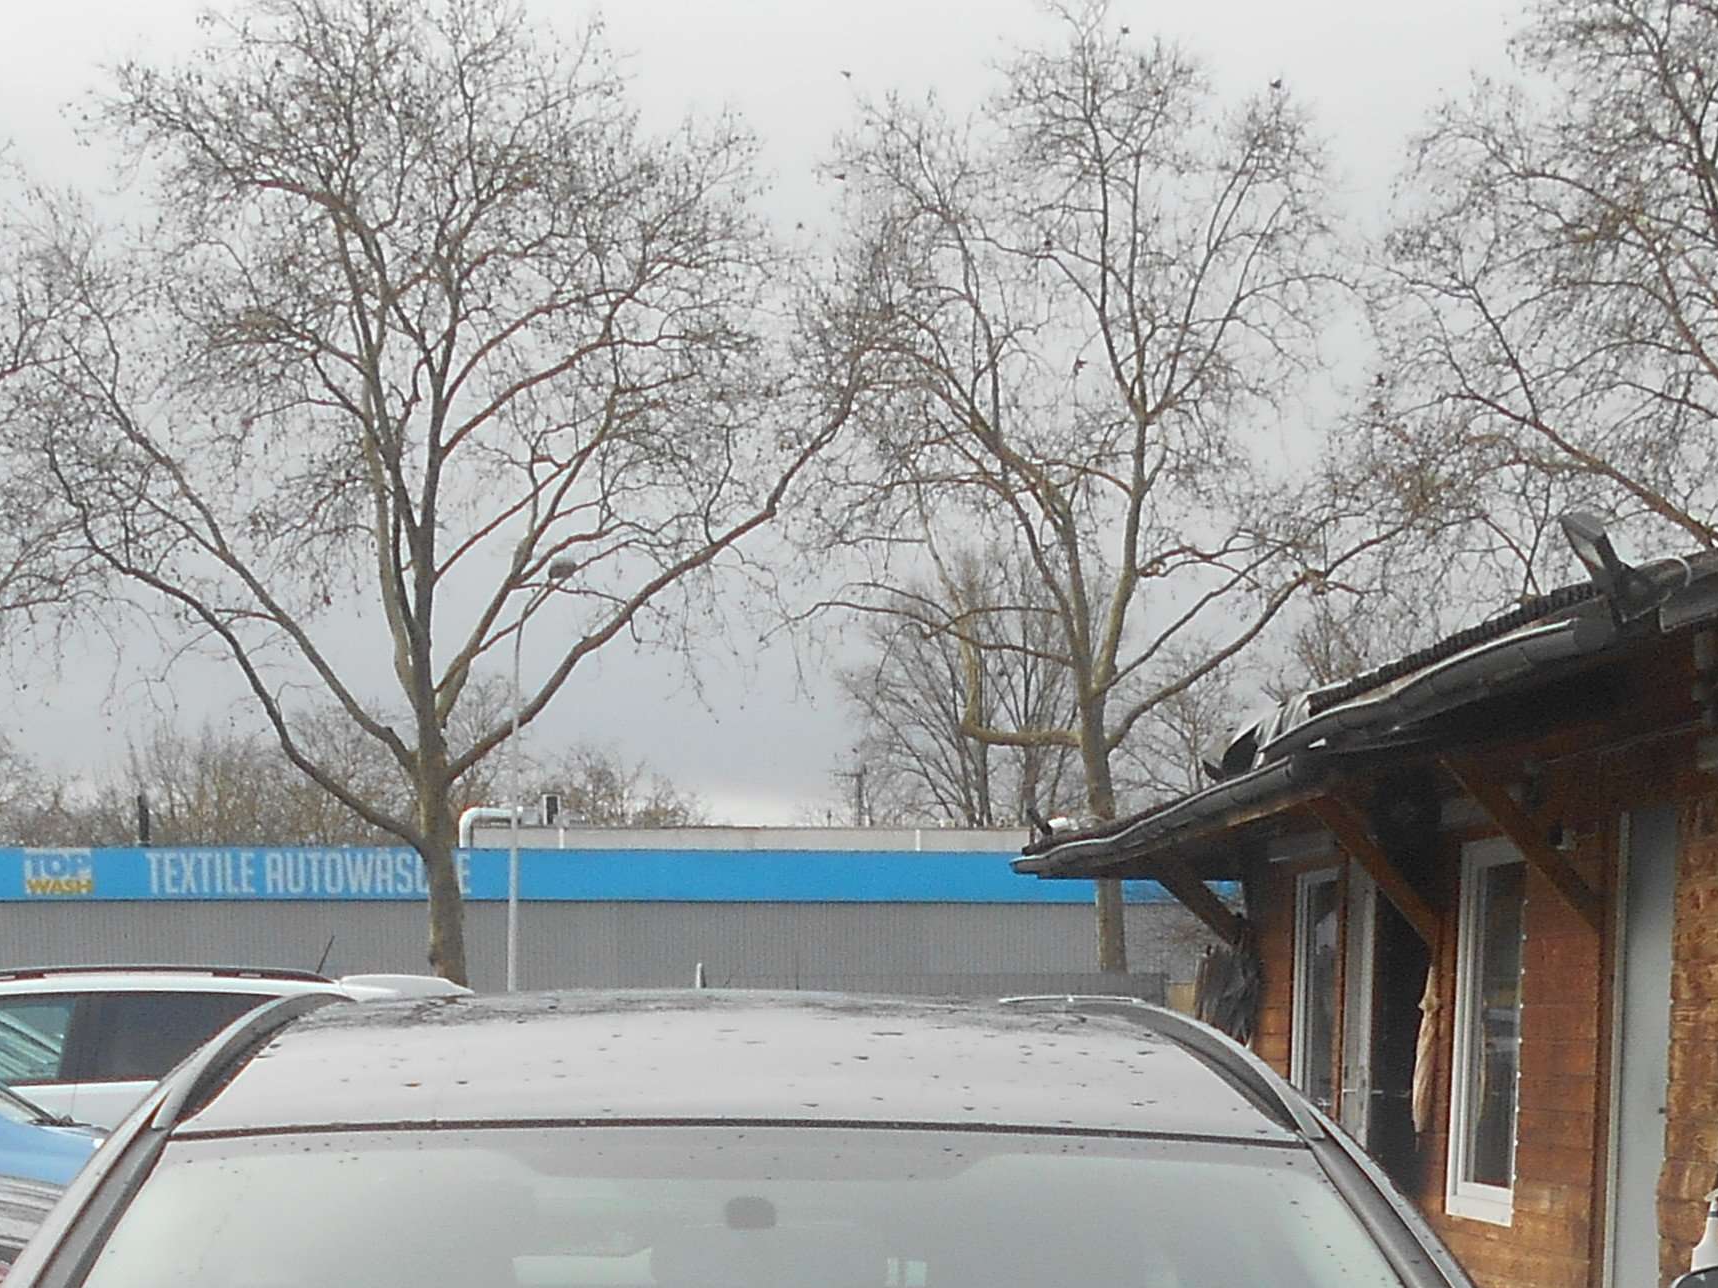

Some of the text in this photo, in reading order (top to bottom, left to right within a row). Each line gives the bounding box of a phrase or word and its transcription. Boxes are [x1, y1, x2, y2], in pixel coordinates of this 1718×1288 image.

[25, 850, 91, 879] TOP
[145, 848, 471, 894] TEXTILE AUTOWÄSCE
[26, 879, 92, 894] WASH
